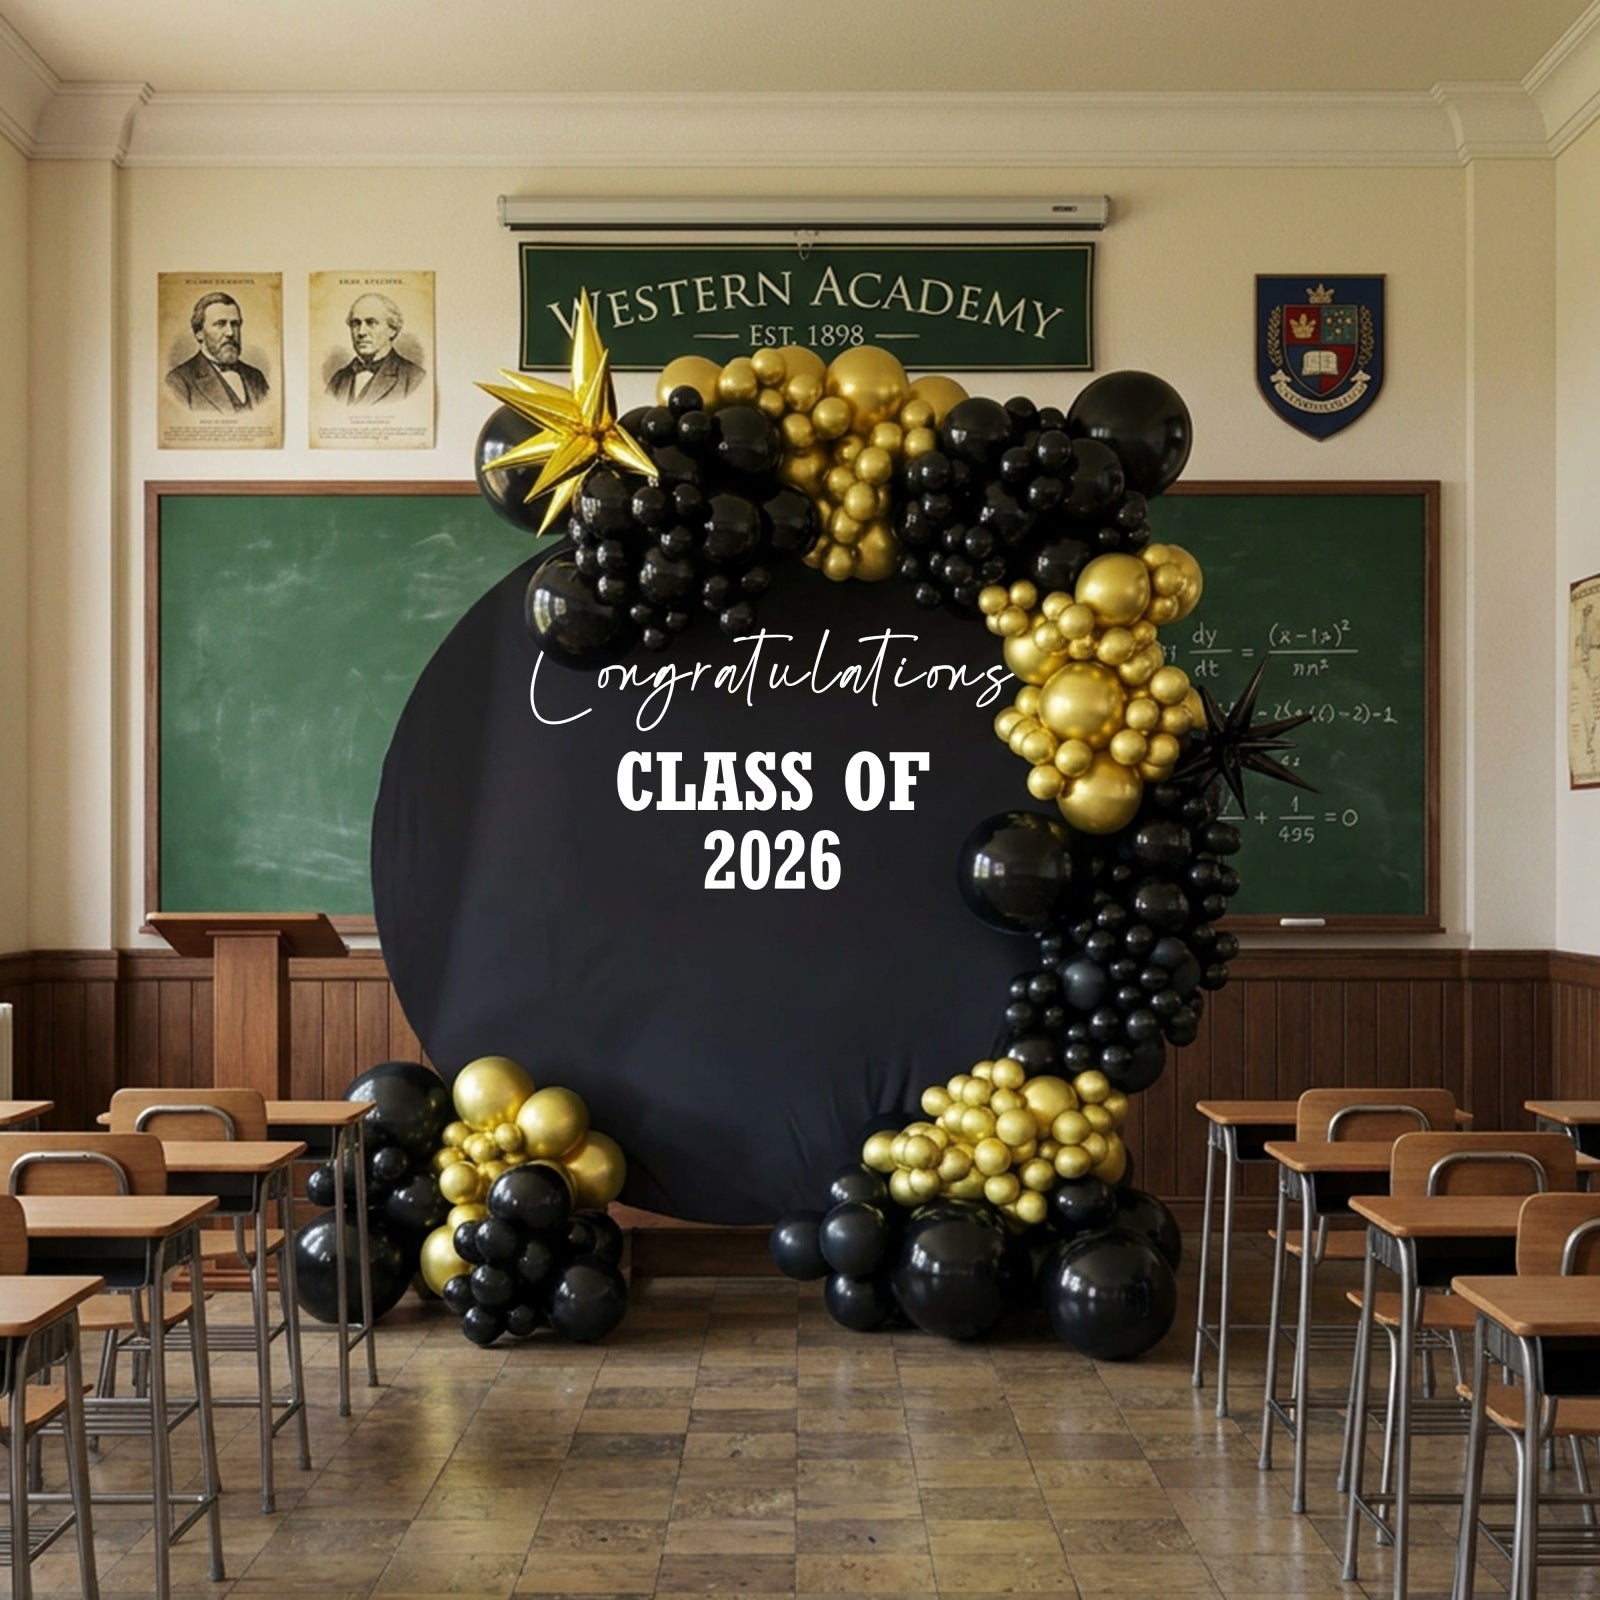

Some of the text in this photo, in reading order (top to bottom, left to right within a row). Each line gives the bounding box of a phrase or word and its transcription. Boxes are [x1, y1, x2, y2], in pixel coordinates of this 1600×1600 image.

[546, 265, 1065, 340] WESTERN ACADEMY
[750, 324, 865, 346] EST. 1898
[1191, 622, 1218, 649] dy
[530, 628, 1015, 731] Congratulations
[1194, 659, 1220, 678] dt
[616, 750, 930, 811] CLASS OF
[1278, 825, 1316, 845] 495
[703, 829, 842, 890] 2026
